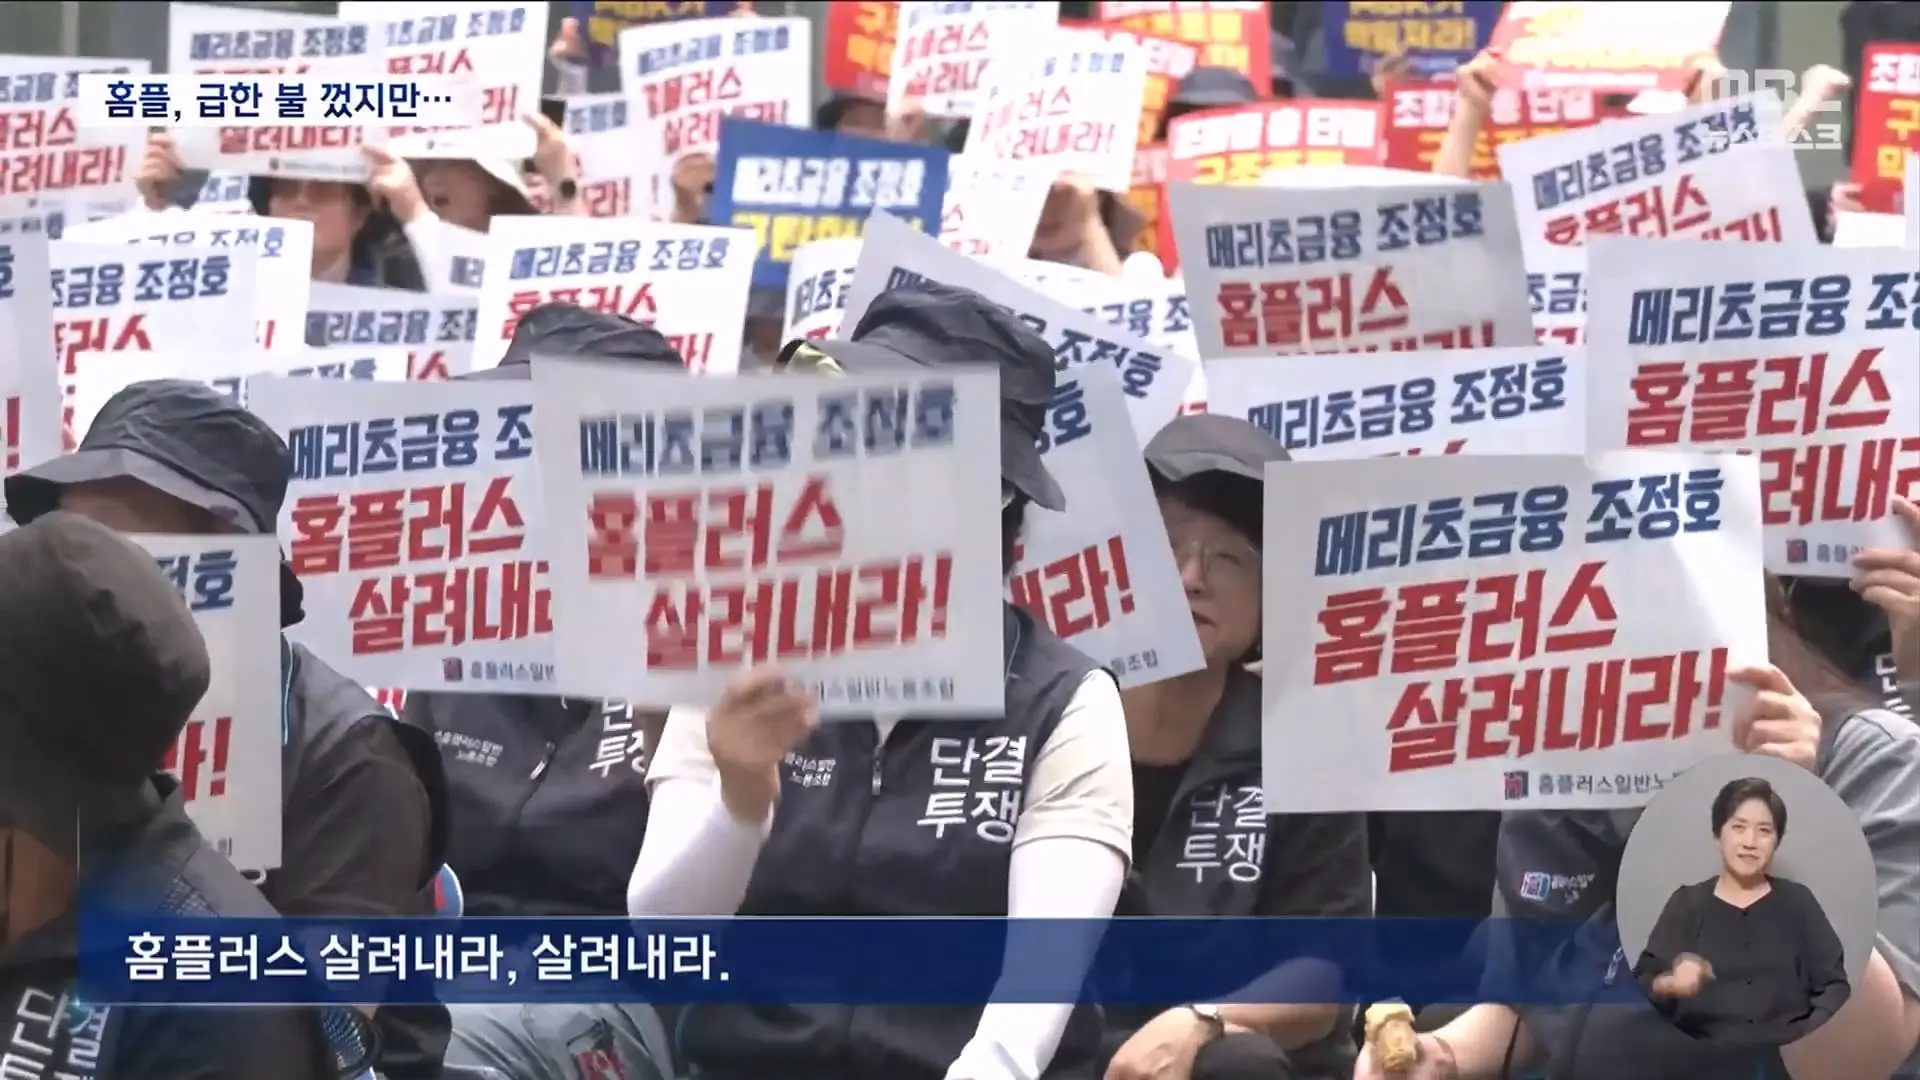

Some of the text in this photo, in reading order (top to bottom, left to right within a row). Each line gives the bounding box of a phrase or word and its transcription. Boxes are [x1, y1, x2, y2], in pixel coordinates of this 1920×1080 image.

[301, 24, 368, 57] 조정호
[1533, 132, 1668, 210] 메리츠금융
[509, 240, 642, 280] 메리츠금융
[648, 237, 730, 272] 조정호
[1206, 192, 1485, 269] 메리츠금융 조정호
[134, 255, 231, 302] 조정호
[1216, 265, 1409, 348] 홈플러스
[1628, 274, 1852, 346] 메리츠금융
[54, 313, 153, 361] 러스
[304, 309, 430, 347] 메리츠금융
[580, 381, 956, 475] 메리츠금융 조정호
[1248, 357, 1568, 450] 메리츠금융 조정호
[1626, 347, 1892, 447] 홈플러스
[289, 409, 480, 480] 메리츠금융
[290, 476, 526, 577] 홈플러스
[588, 474, 845, 580] 홈플러스
[1314, 467, 1725, 577] 메리츠금융 조정호
[644, 555, 954, 672] 살려내라!
[1313, 561, 1618, 686] 홈플러스
[1386, 647, 1729, 773] 살려내라!
[930, 735, 1028, 786] 단결
[917, 789, 1021, 843] 투쟁
[1175, 832, 1266, 884] 투쟁
